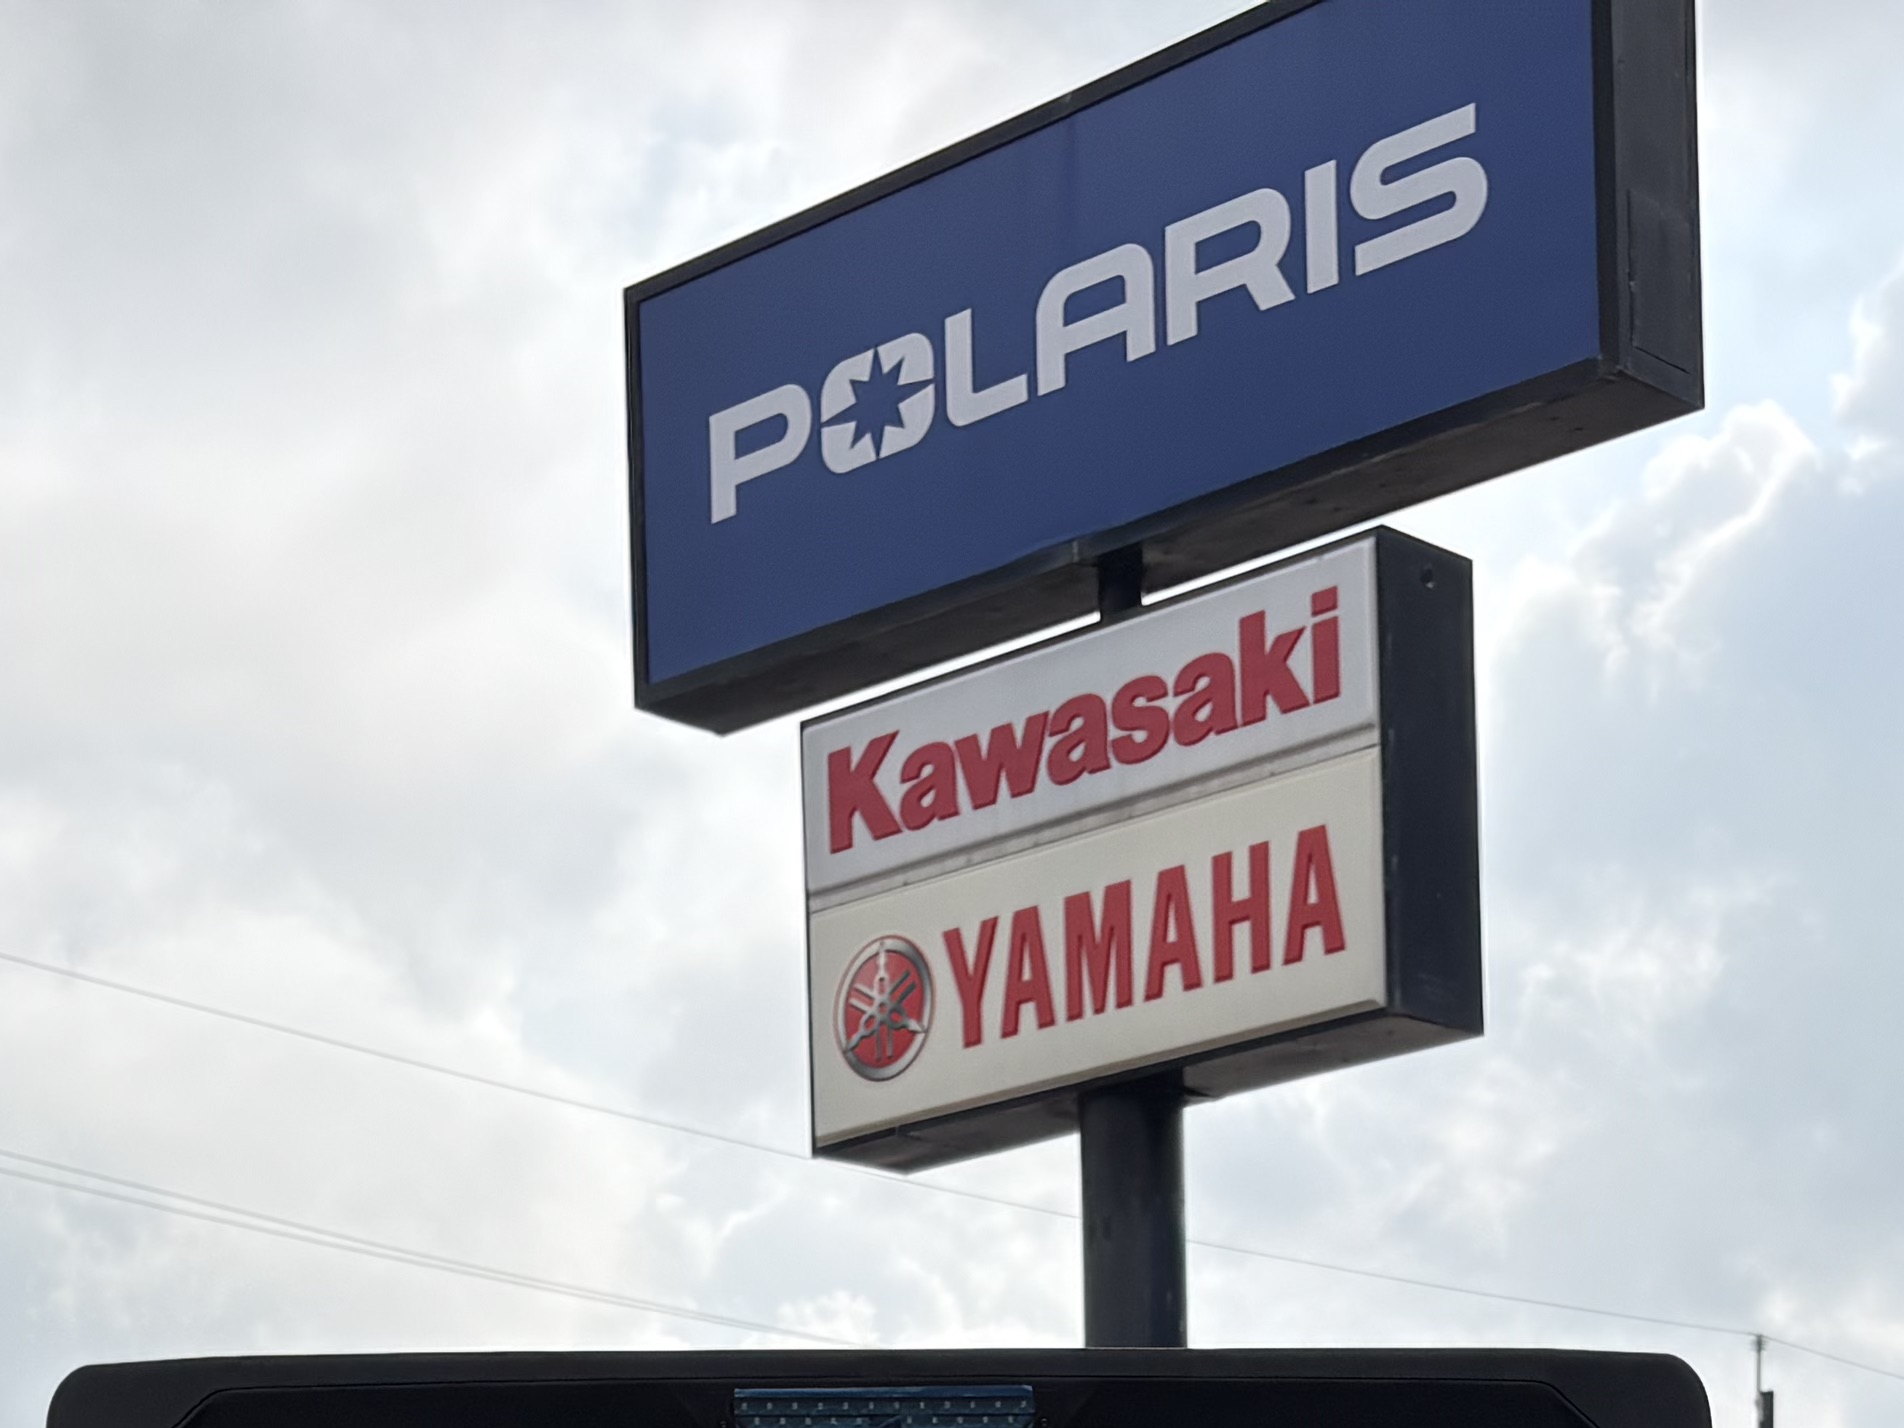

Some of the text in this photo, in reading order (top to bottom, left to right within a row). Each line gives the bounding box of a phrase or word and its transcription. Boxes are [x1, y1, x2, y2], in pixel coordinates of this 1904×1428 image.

[707, 102, 1489, 524] POLARIS
[826, 585, 1341, 854] Kawasaki
[942, 823, 1347, 1049] YAMAHA
